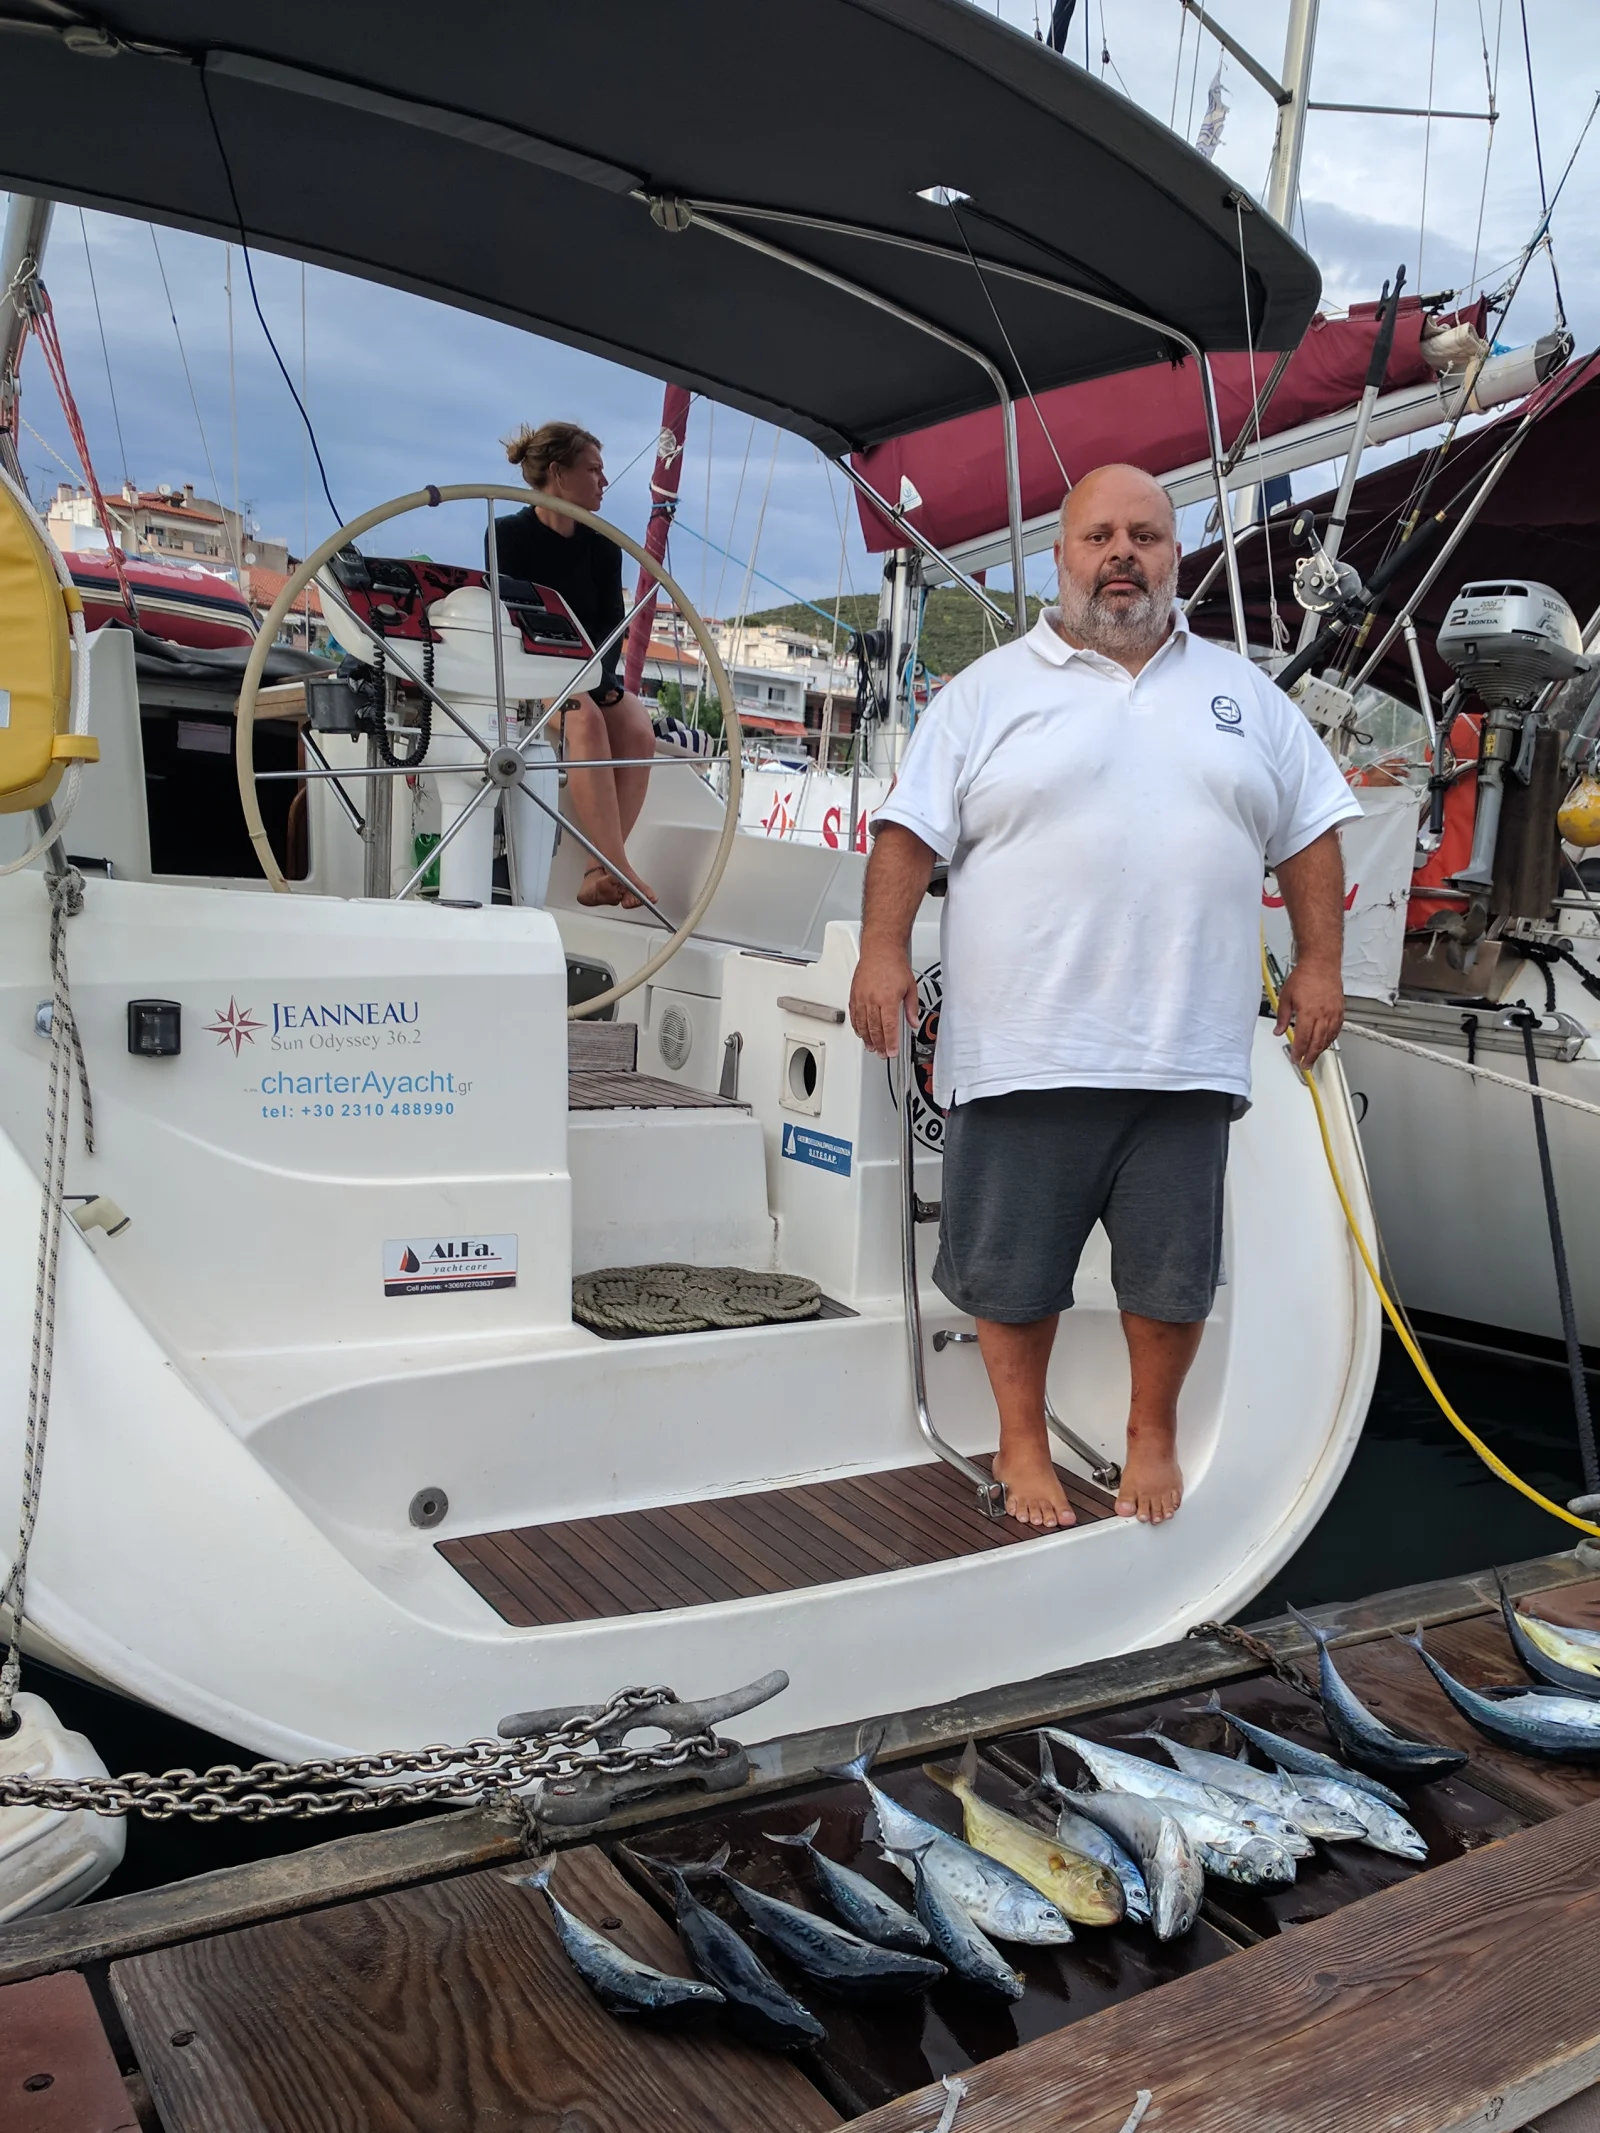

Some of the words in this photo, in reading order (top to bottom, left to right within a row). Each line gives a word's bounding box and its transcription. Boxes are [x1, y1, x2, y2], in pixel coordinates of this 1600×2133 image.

[1449, 608, 1469, 626] 2
[272, 1001, 419, 1037] JEANNEAU
[271, 1035, 304, 1051] Sun
[309, 1032, 381, 1052] Odyssey
[387, 1029, 422, 1046] 36.2
[261, 1070, 473, 1099] charterAyacht.gr
[262, 1104, 294, 1118] tel:
[301, 1103, 335, 1117] +30
[341, 1103, 384, 1117] 2310
[390, 1102, 454, 1116] 488990
[429, 1241, 495, 1259] Al.Fa.
[433, 1263, 463, 1274] yacht
[465, 1263, 488, 1271] care
[406, 1284, 420, 1292] Cell
[420, 1283, 442, 1293] phone:
